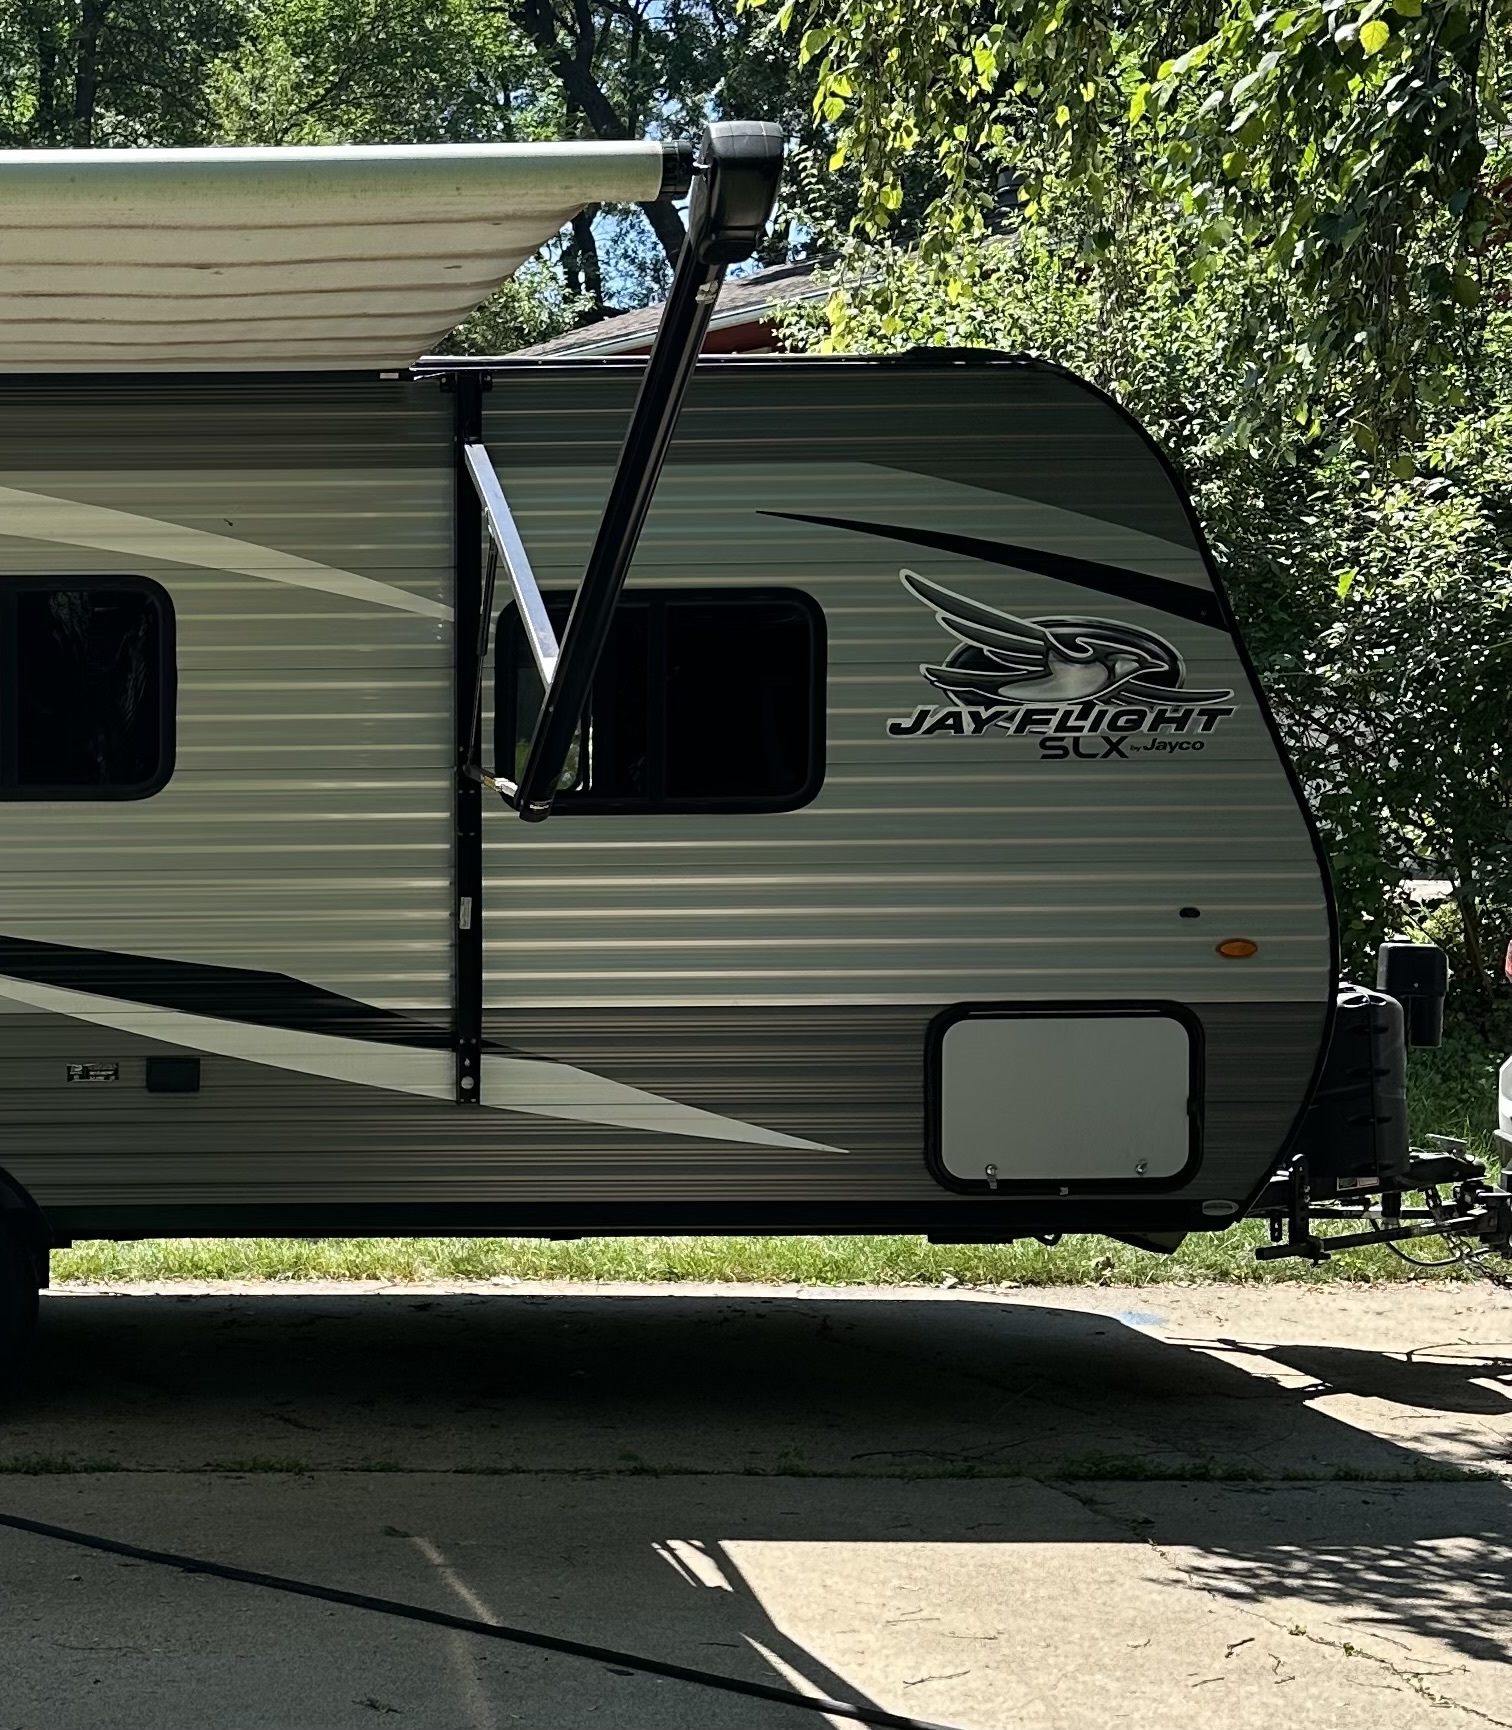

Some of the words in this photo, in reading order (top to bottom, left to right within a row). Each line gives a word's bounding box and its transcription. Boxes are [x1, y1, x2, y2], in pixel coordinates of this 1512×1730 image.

[888, 704, 1011, 737] JAY
[1005, 703, 1238, 737] FLIGHT
[1039, 736, 1130, 759] SLX
[1130, 744, 1142, 752] by
[1143, 737, 1205, 754] Jayco
